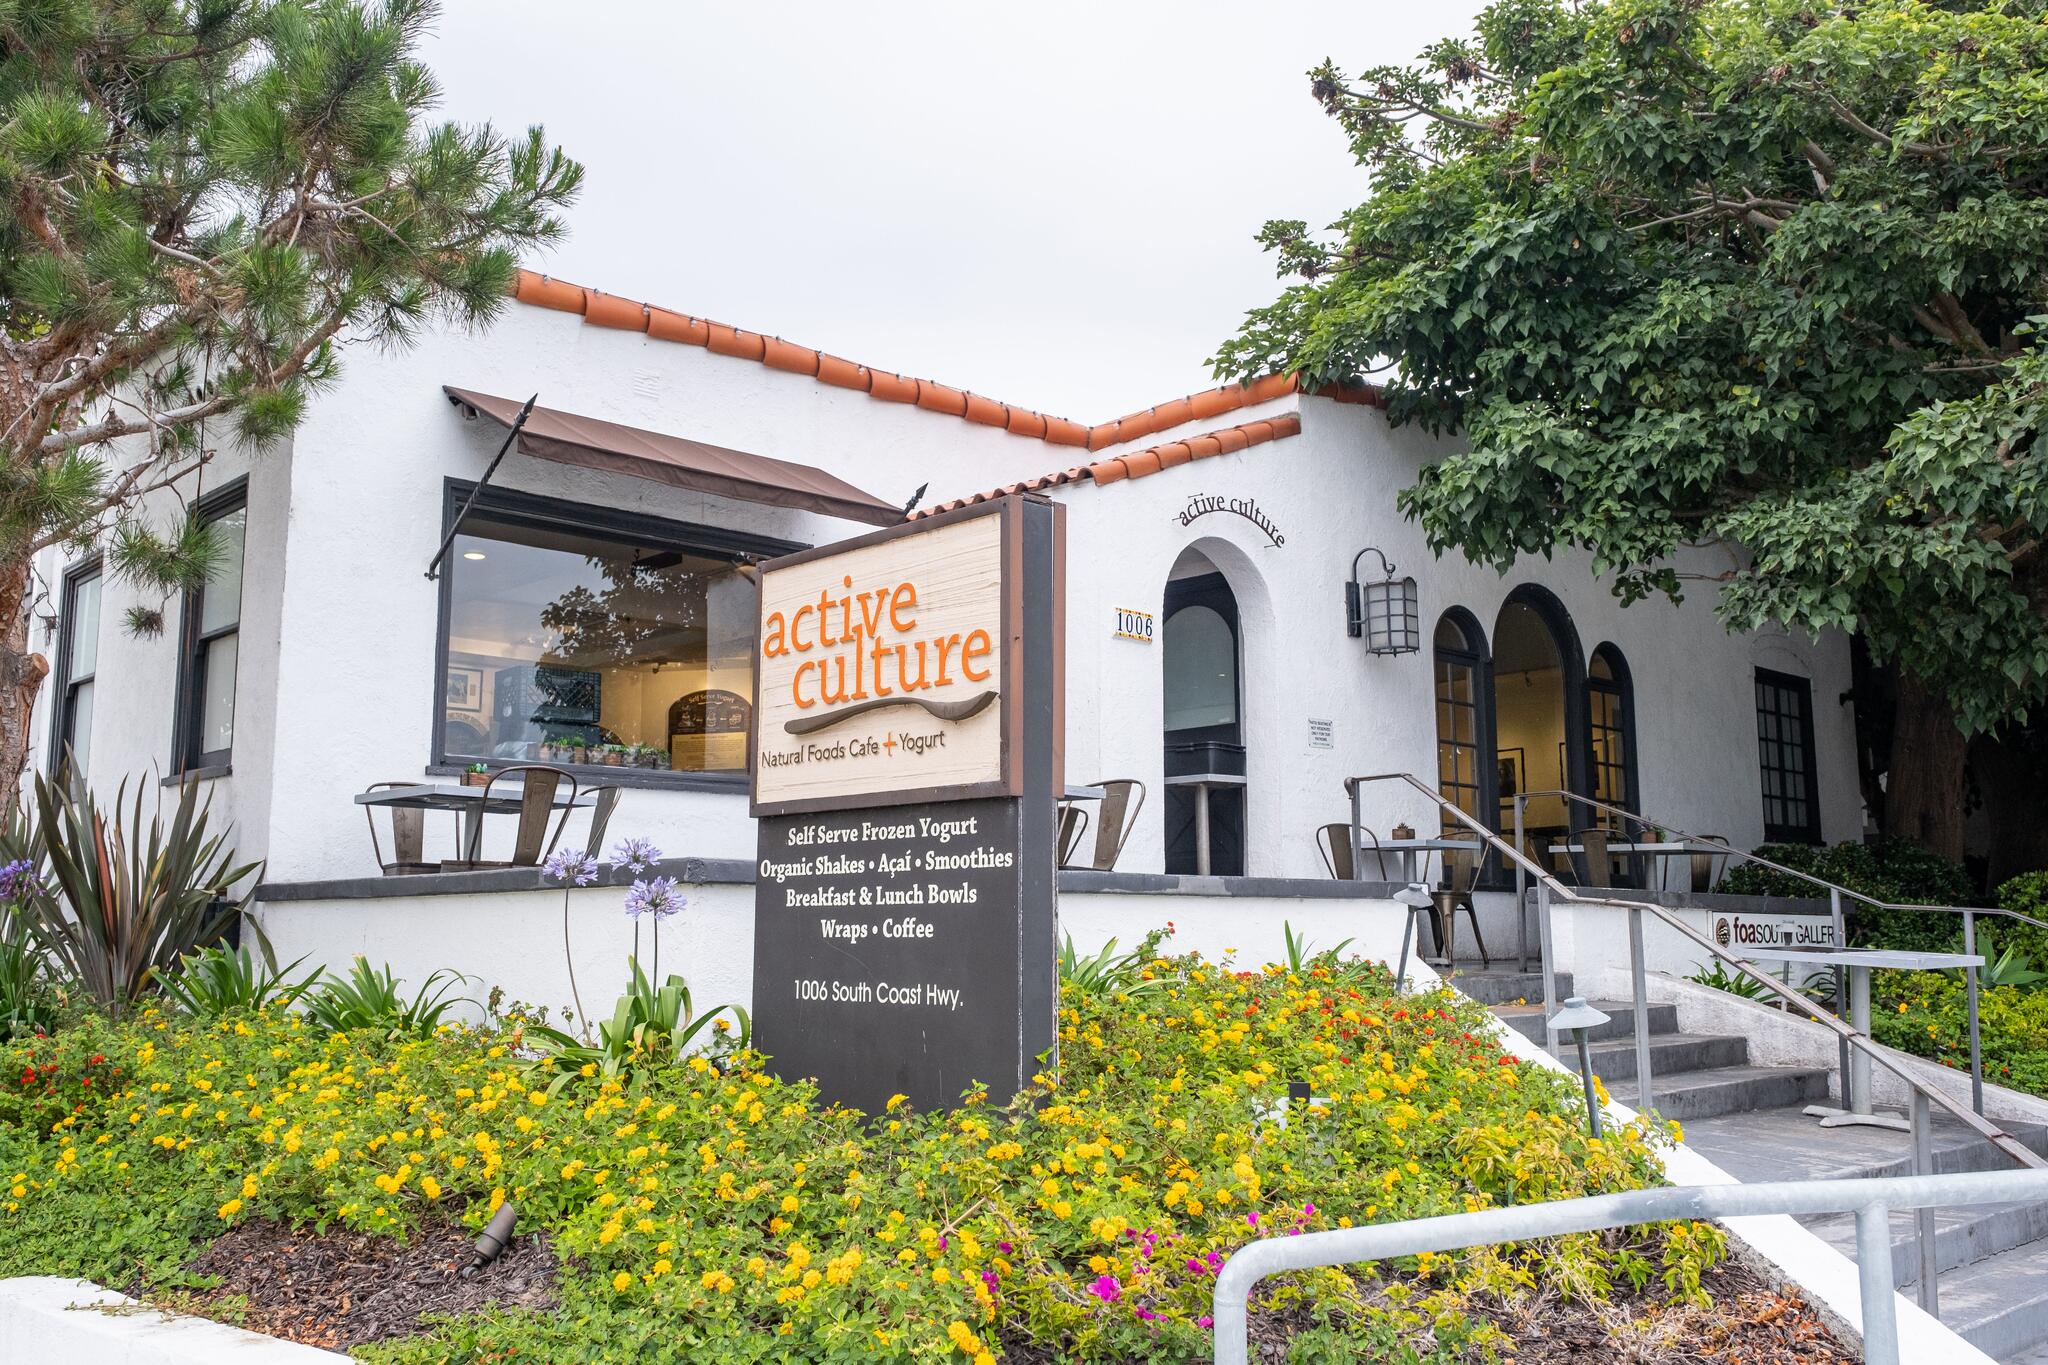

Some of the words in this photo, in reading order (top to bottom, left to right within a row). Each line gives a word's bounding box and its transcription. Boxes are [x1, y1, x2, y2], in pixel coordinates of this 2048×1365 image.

[1179, 493, 1225, 527] active
[1230, 498, 1285, 548] culture
[763, 575, 917, 658] active
[1118, 612, 1153, 637] 1006
[792, 624, 992, 709] culture
[761, 744, 804, 769] Natural
[807, 740, 845, 763] Foods
[849, 736, 879, 758] Cafe
[899, 730, 945, 757] Yogurt
[787, 826, 816, 846] Self
[817, 825, 859, 844] Serve
[861, 822, 916, 842] Frozen
[918, 816, 978, 843] Yogurt
[760, 856, 813, 883] Organic
[815, 854, 866, 876] Shakes
[877, 849, 912, 879] Açaí
[925, 846, 1013, 870] Smoothies
[785, 886, 856, 908] Breakfast
[858, 886, 873, 906] &
[875, 884, 924, 906] Lunch
[927, 882, 978, 904] Bowls
[820, 919, 868, 945] Wraps
[882, 916, 934, 939] Coffee
[1796, 924, 1836, 945] GALLER
[794, 979, 828, 1001] 1006
[831, 980, 872, 1003] South
[876, 982, 922, 1005] Coast
[926, 983, 964, 1011] Hwy.
